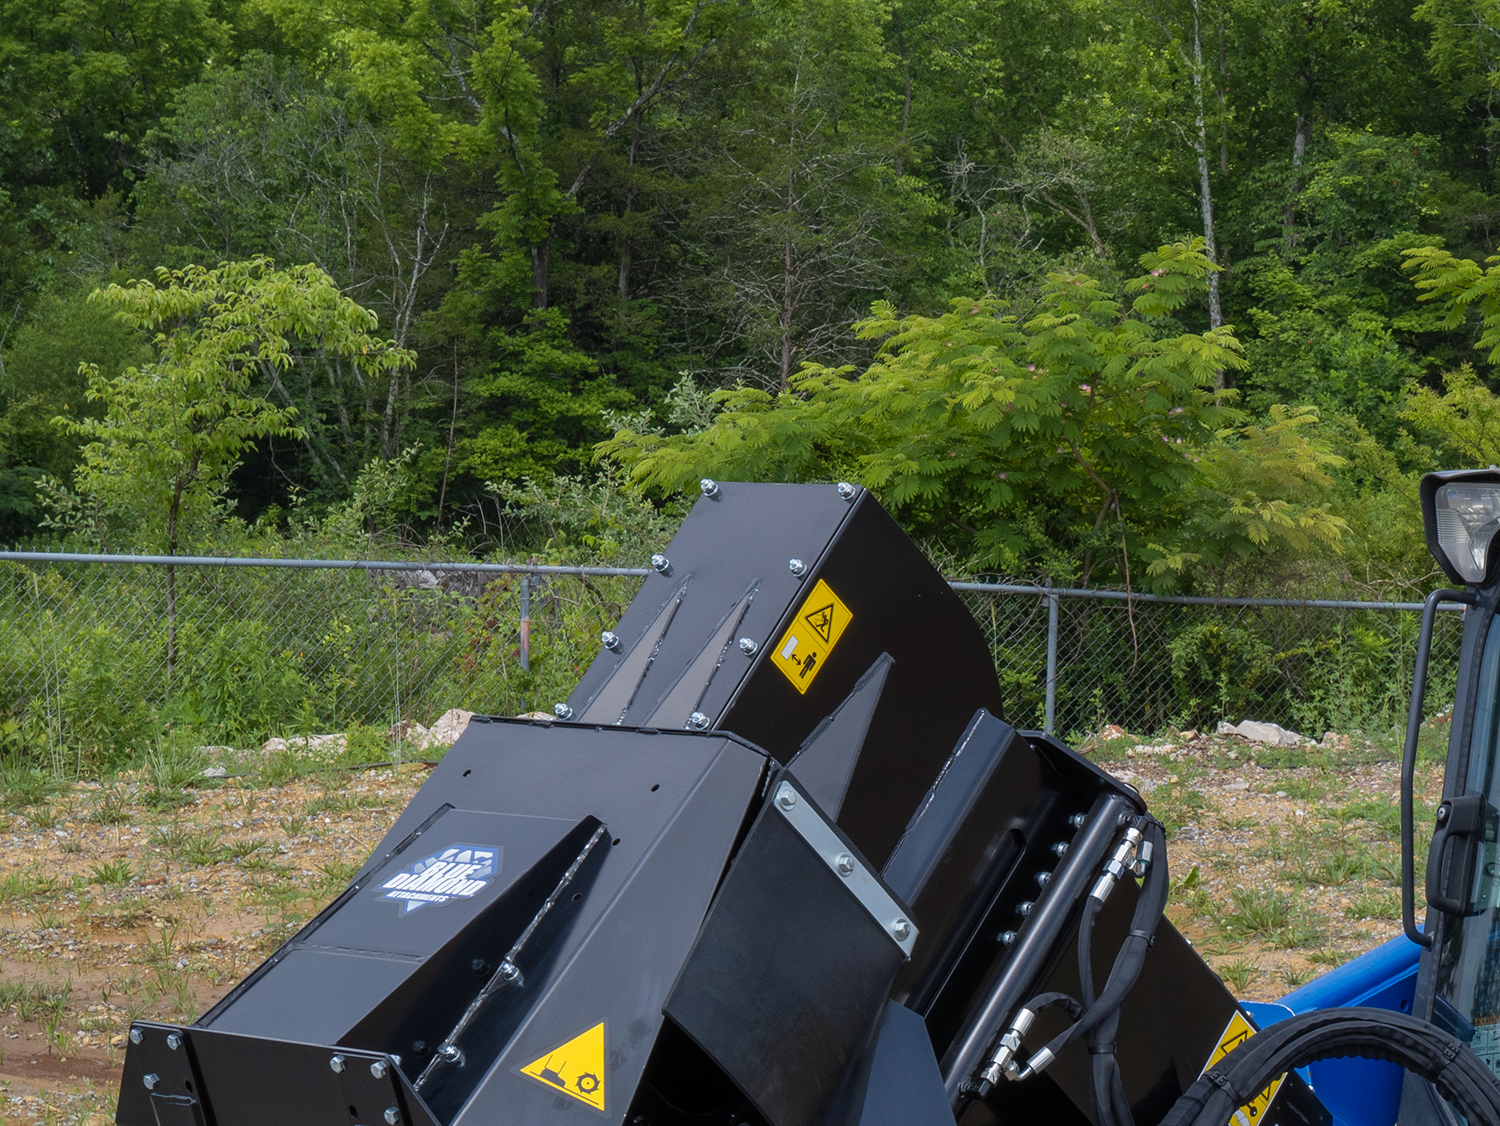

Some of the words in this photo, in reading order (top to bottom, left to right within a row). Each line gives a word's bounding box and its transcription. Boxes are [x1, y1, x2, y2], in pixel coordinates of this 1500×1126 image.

[419, 861, 482, 880] BLUE
[382, 872, 487, 896] DIAMOND
[386, 890, 449, 902] ATTACHMENTS
